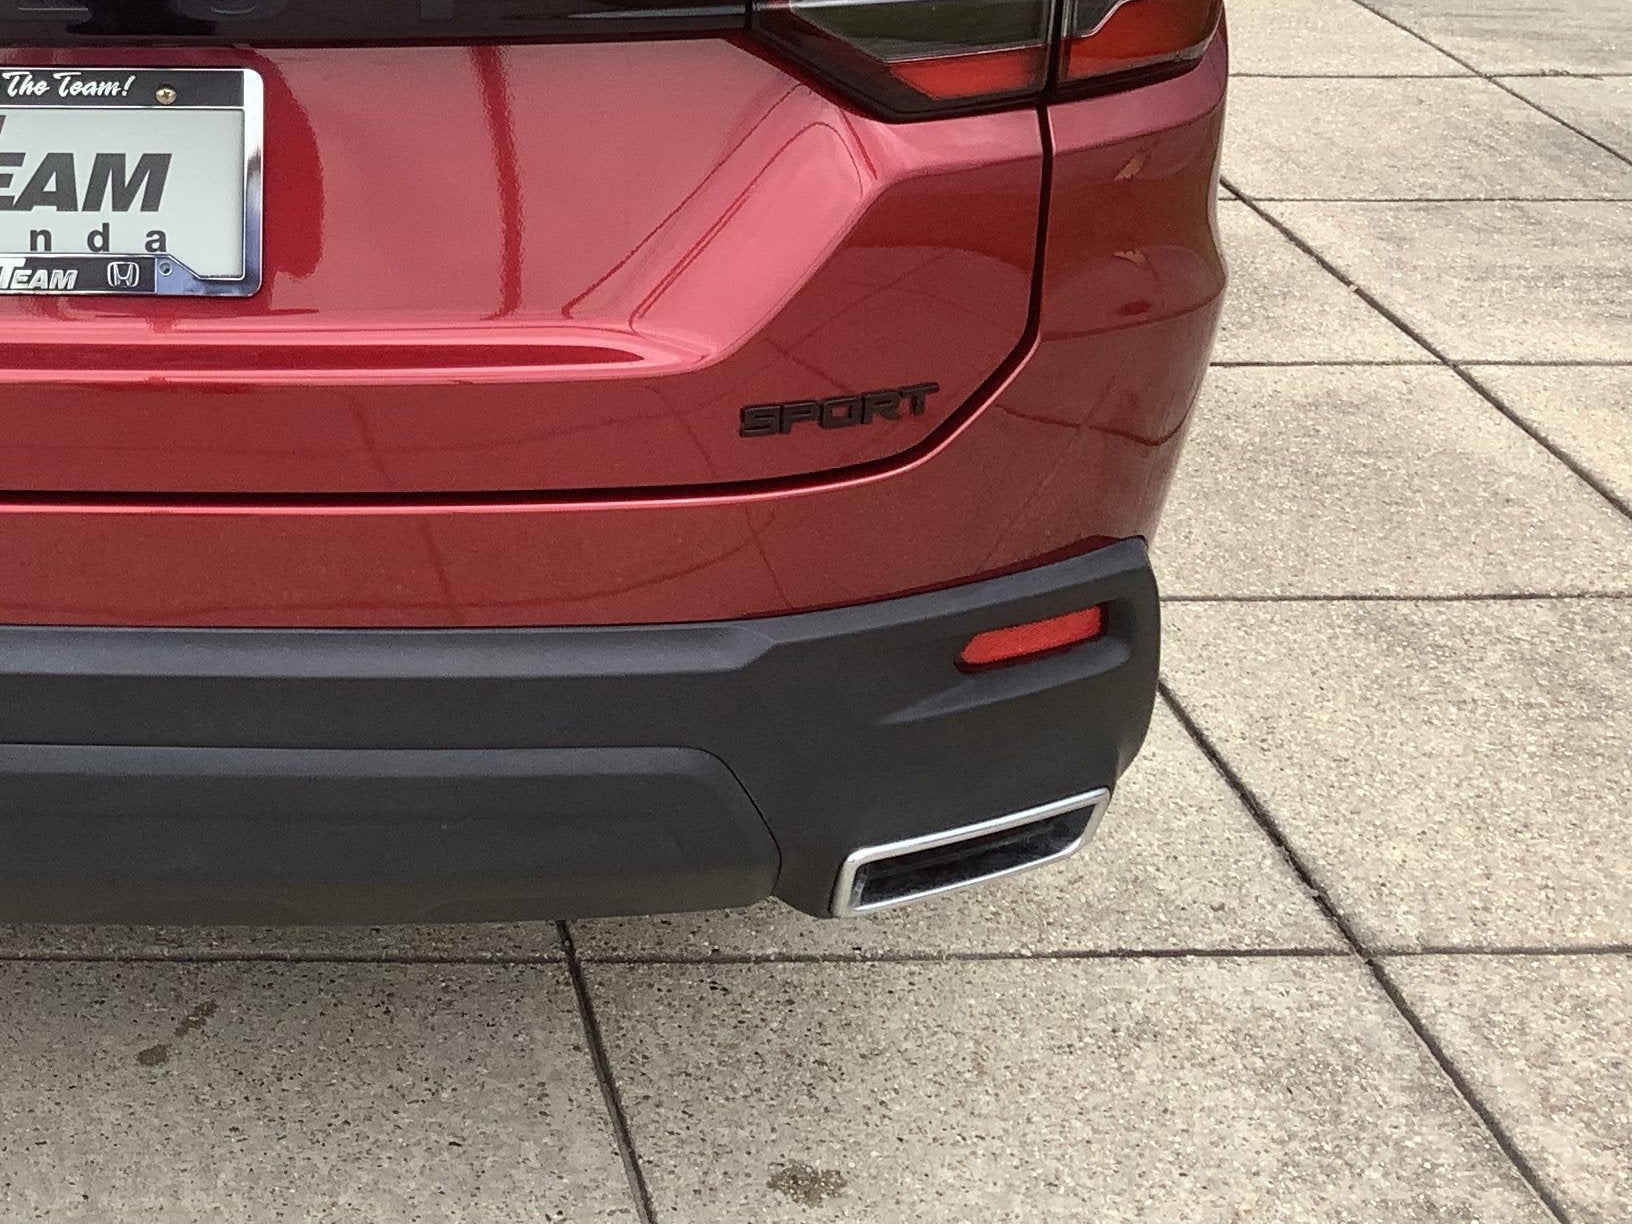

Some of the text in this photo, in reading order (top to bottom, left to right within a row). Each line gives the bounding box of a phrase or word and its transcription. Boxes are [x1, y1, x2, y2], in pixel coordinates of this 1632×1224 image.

[2, 71, 50, 97] The
[53, 72, 136, 97] Team!
[738, 381, 940, 437] SPORT
